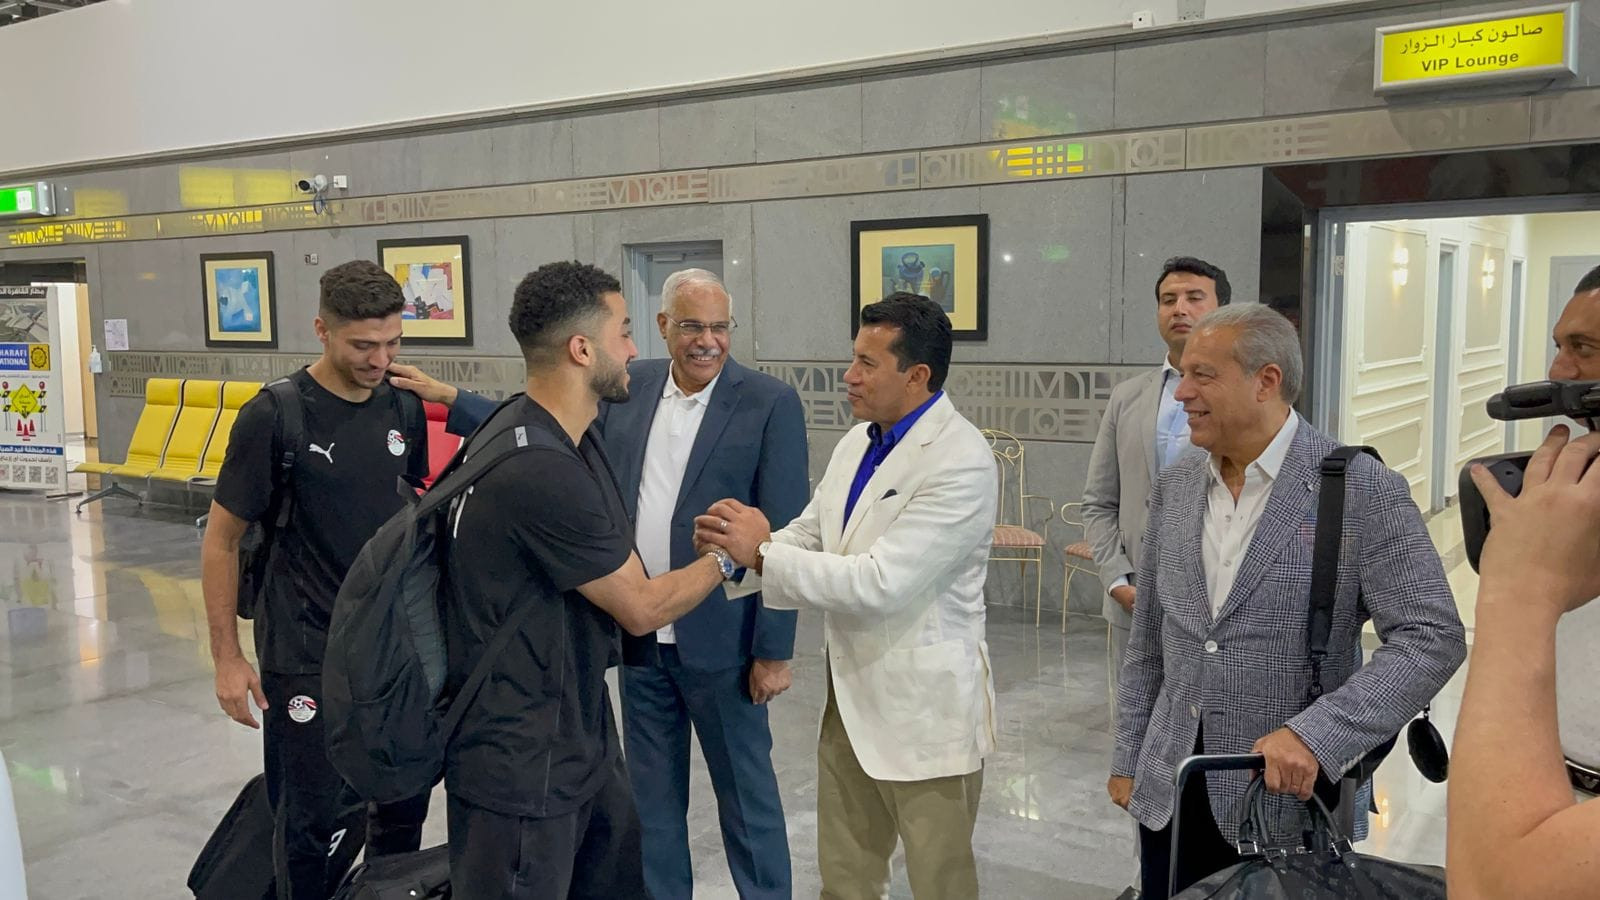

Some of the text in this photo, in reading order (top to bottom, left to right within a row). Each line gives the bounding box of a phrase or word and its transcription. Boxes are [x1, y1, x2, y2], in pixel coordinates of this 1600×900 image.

[1400, 23, 1543, 54] صالون كبار الزوار
[1421, 52, 1519, 72] VIP Lounge
